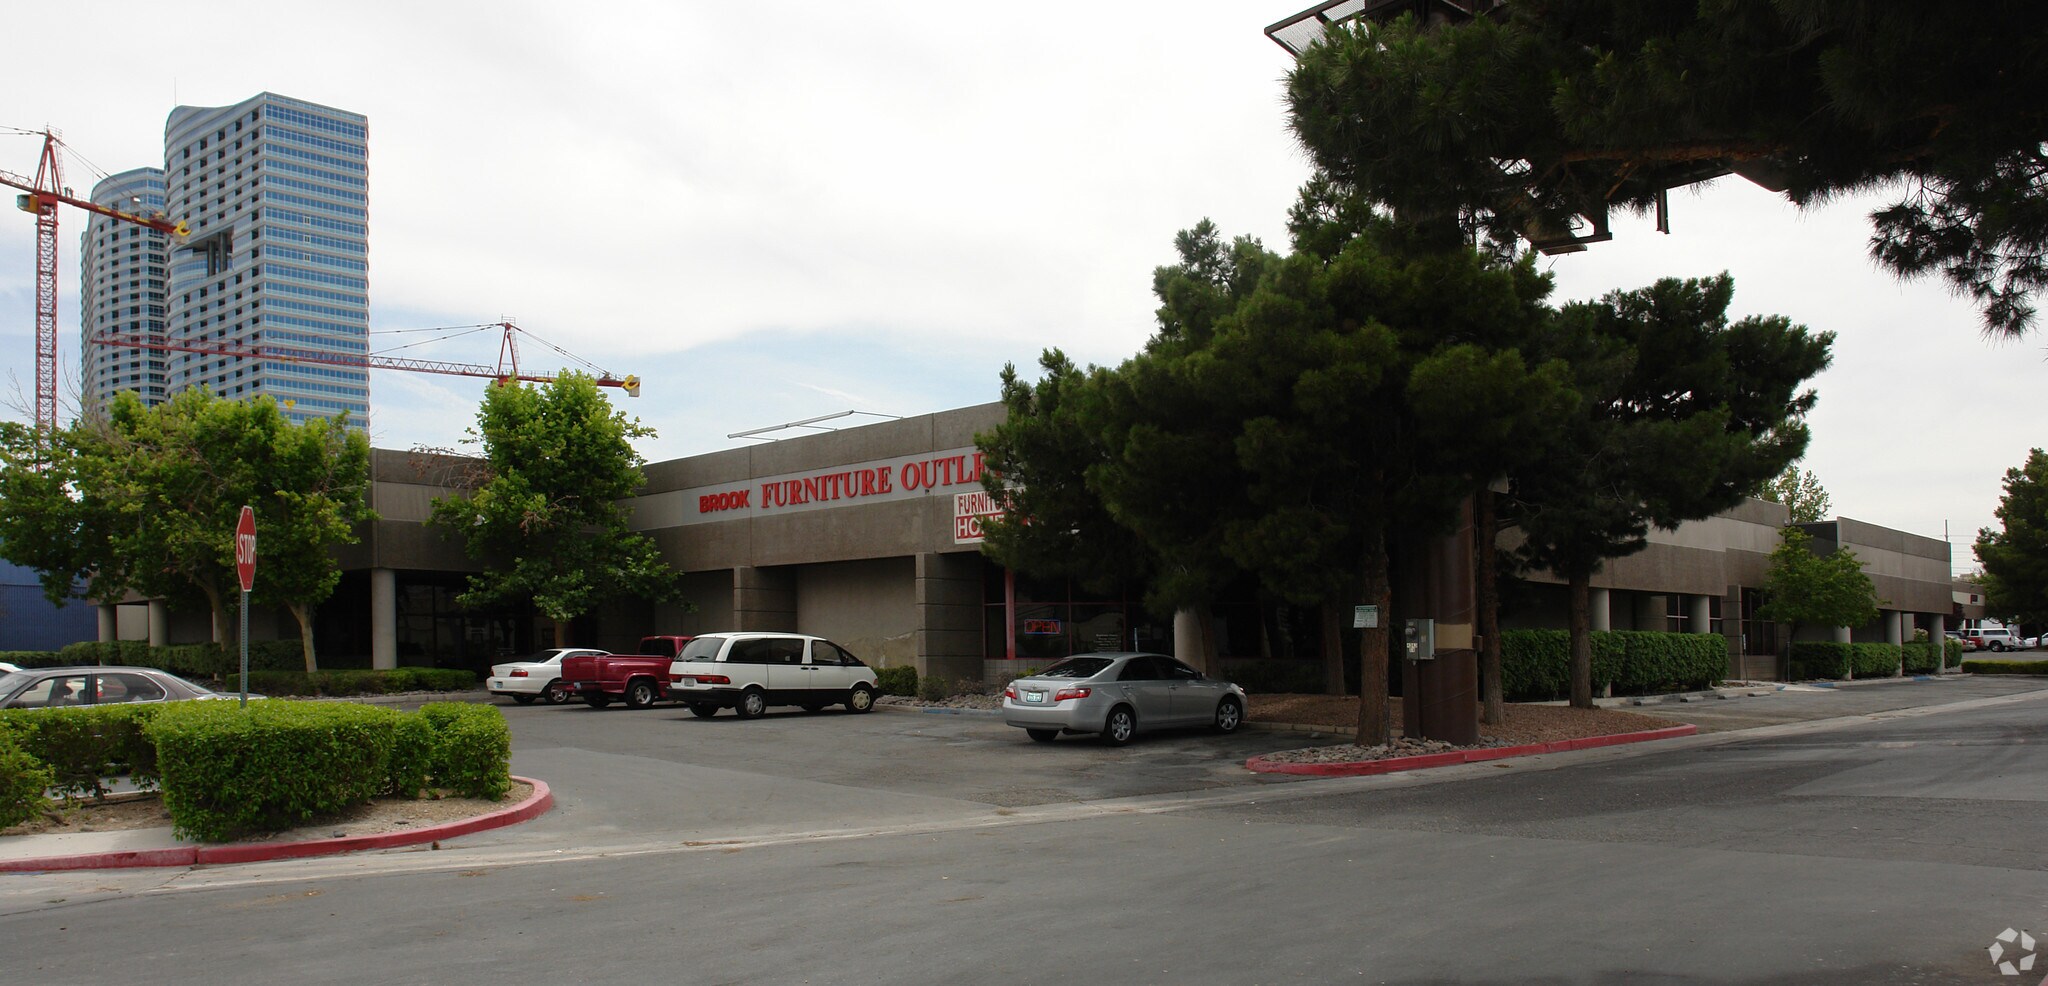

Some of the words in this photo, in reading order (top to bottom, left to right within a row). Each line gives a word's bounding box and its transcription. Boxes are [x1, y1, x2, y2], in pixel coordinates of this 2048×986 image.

[699, 489, 750, 513] BROOK
[761, 466, 892, 508] FURNITURE
[239, 533, 255, 564] STOP
[1025, 621, 1060, 633] OPEN
